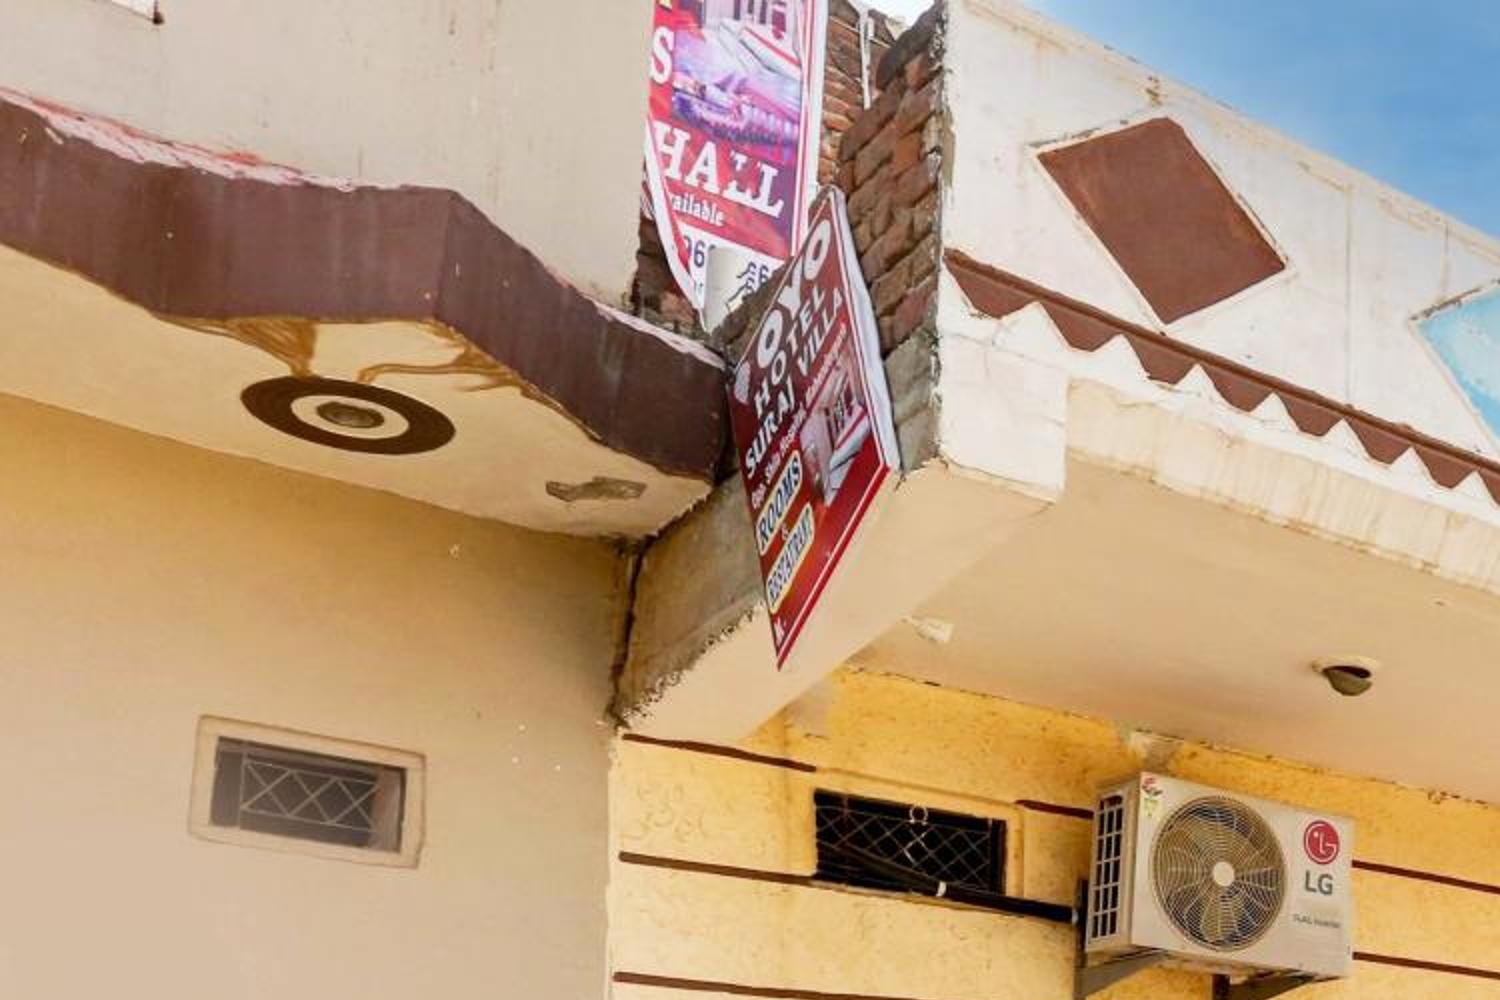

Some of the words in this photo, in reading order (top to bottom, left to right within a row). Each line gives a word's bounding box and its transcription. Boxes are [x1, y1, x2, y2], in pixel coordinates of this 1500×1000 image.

[653, 120, 785, 218] HALL
[757, 219, 831, 369] OYO
[745, 372, 796, 478] SURAJ
[797, 286, 846, 377] VILLA
[754, 286, 825, 420] HOTEL
[758, 456, 800, 551] ROOMS
[1304, 870, 1333, 896] LG
